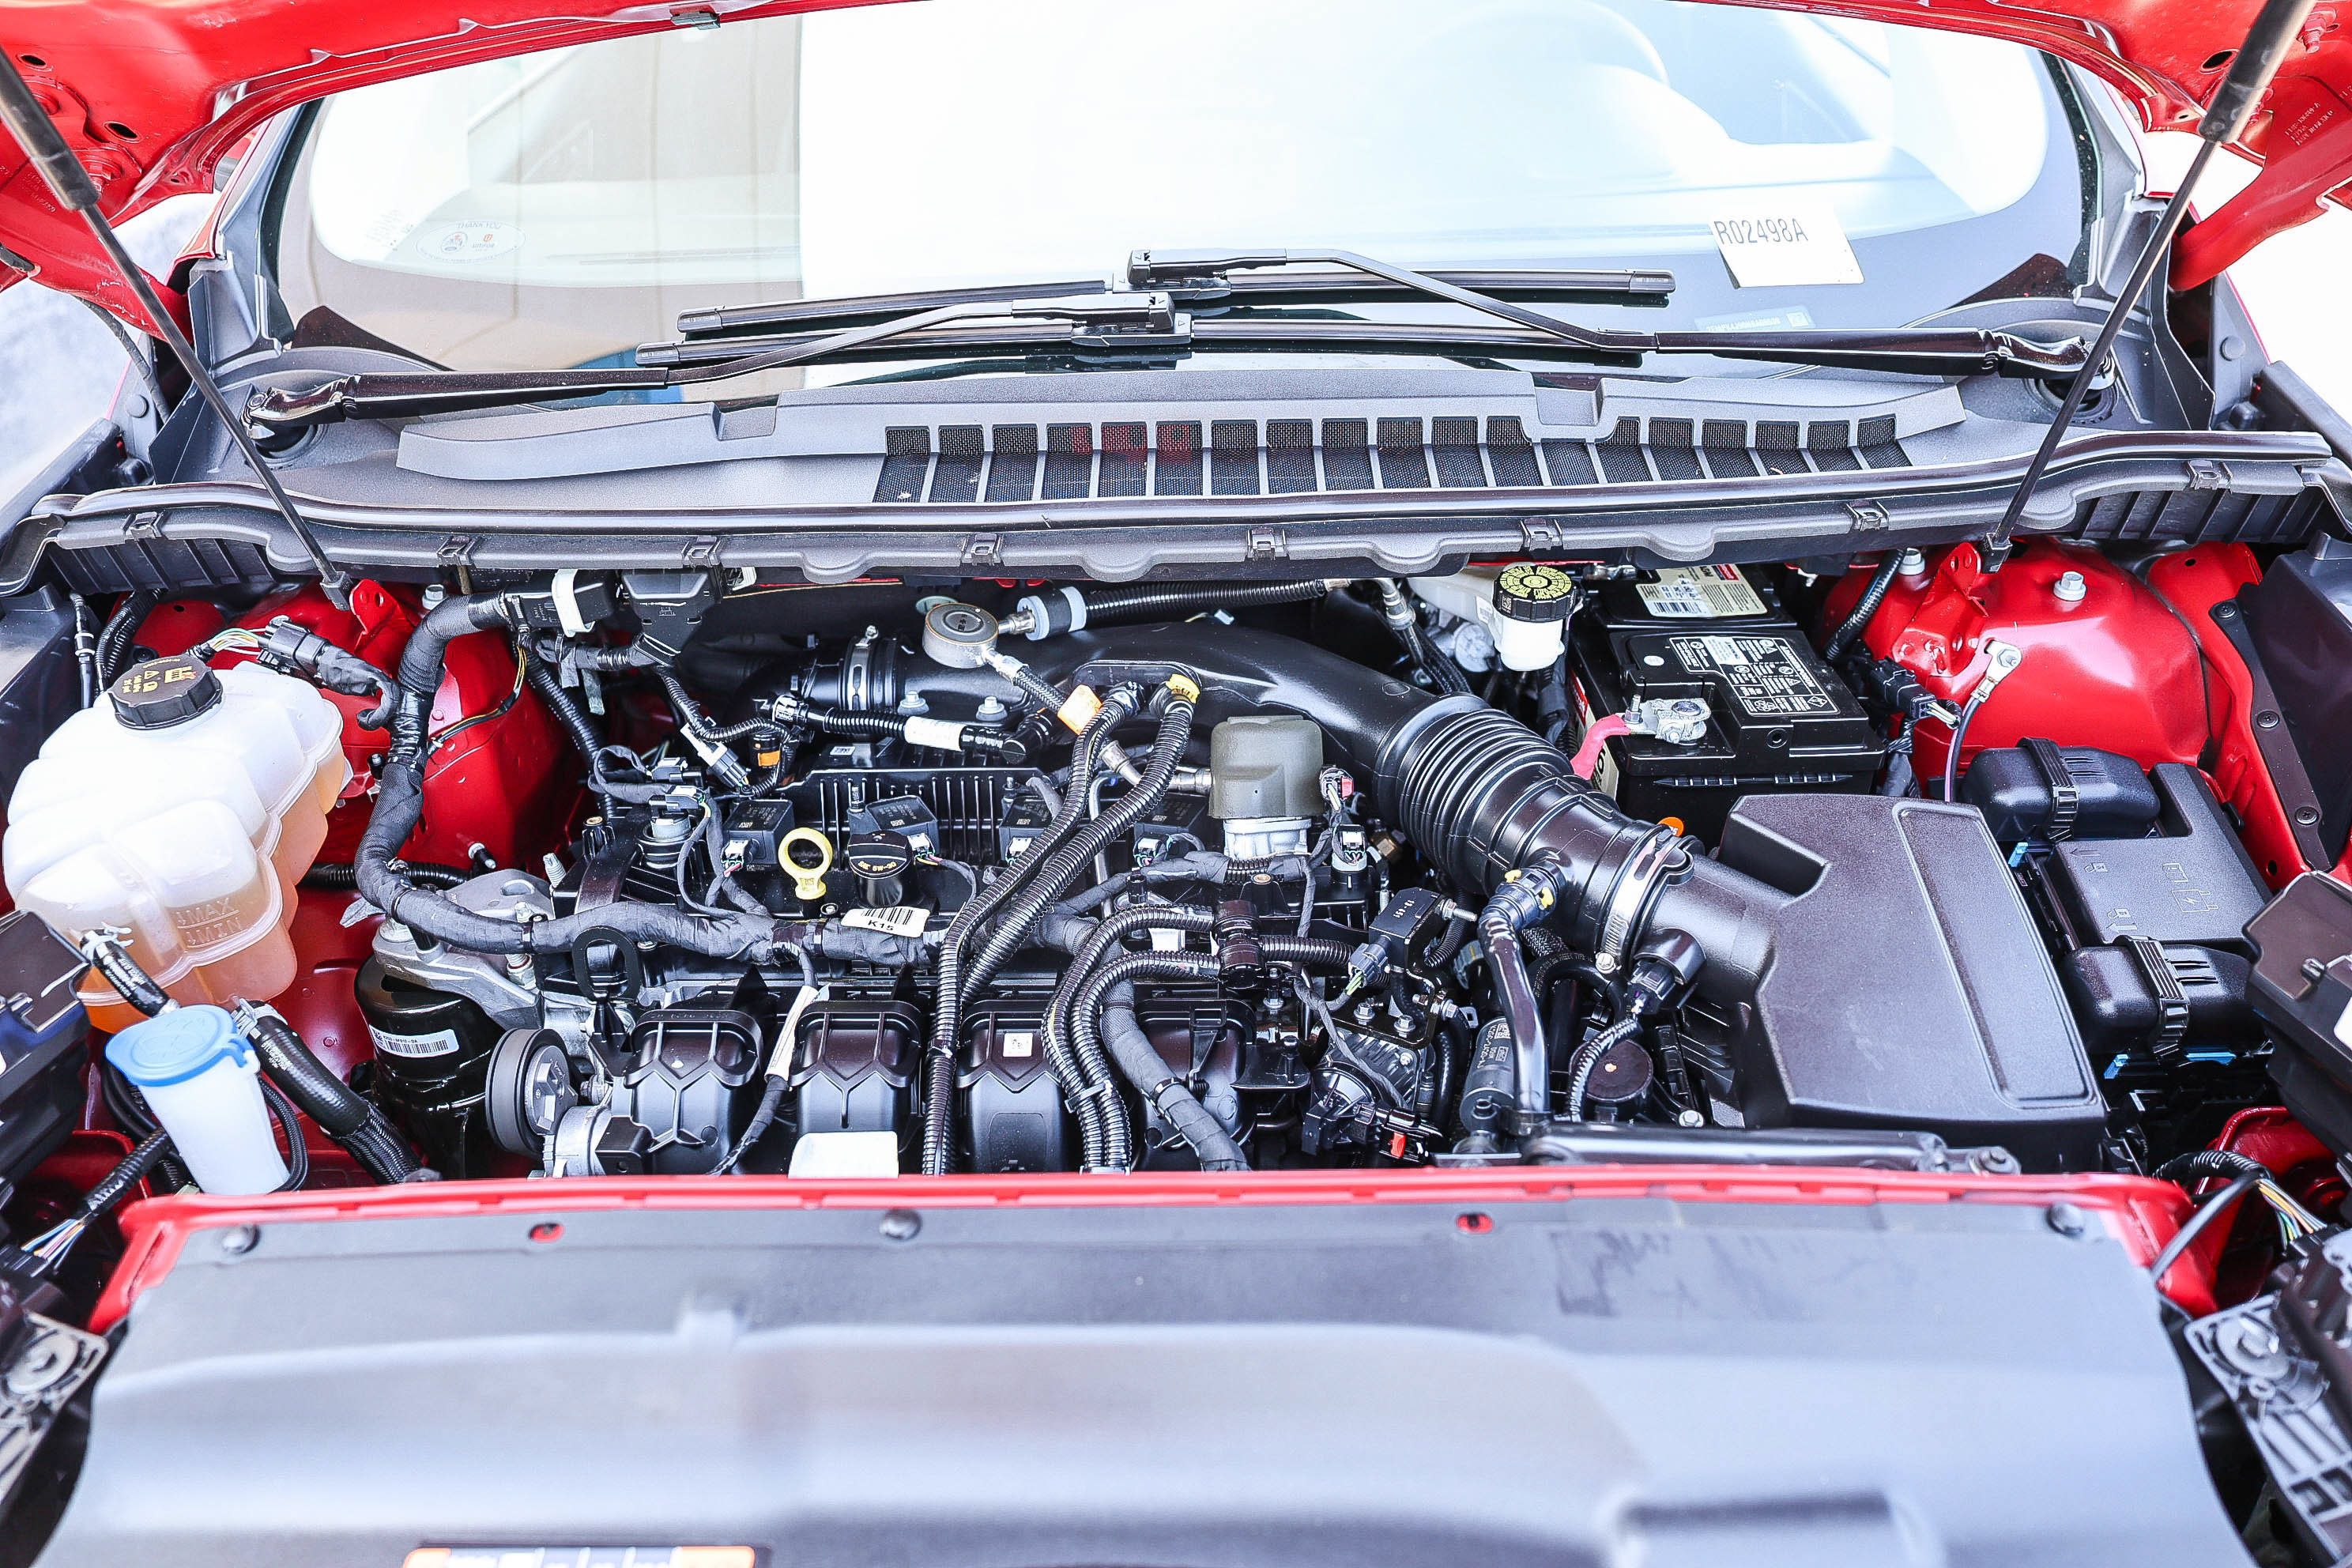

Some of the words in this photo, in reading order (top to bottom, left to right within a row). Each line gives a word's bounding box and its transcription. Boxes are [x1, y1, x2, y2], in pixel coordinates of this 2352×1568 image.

[1713, 217, 1808, 245] R02498A
[873, 861, 898, 872] 5W-30
[187, 897, 236, 924] MAX
[196, 917, 242, 944] MIN
[868, 919, 895, 931] K15
